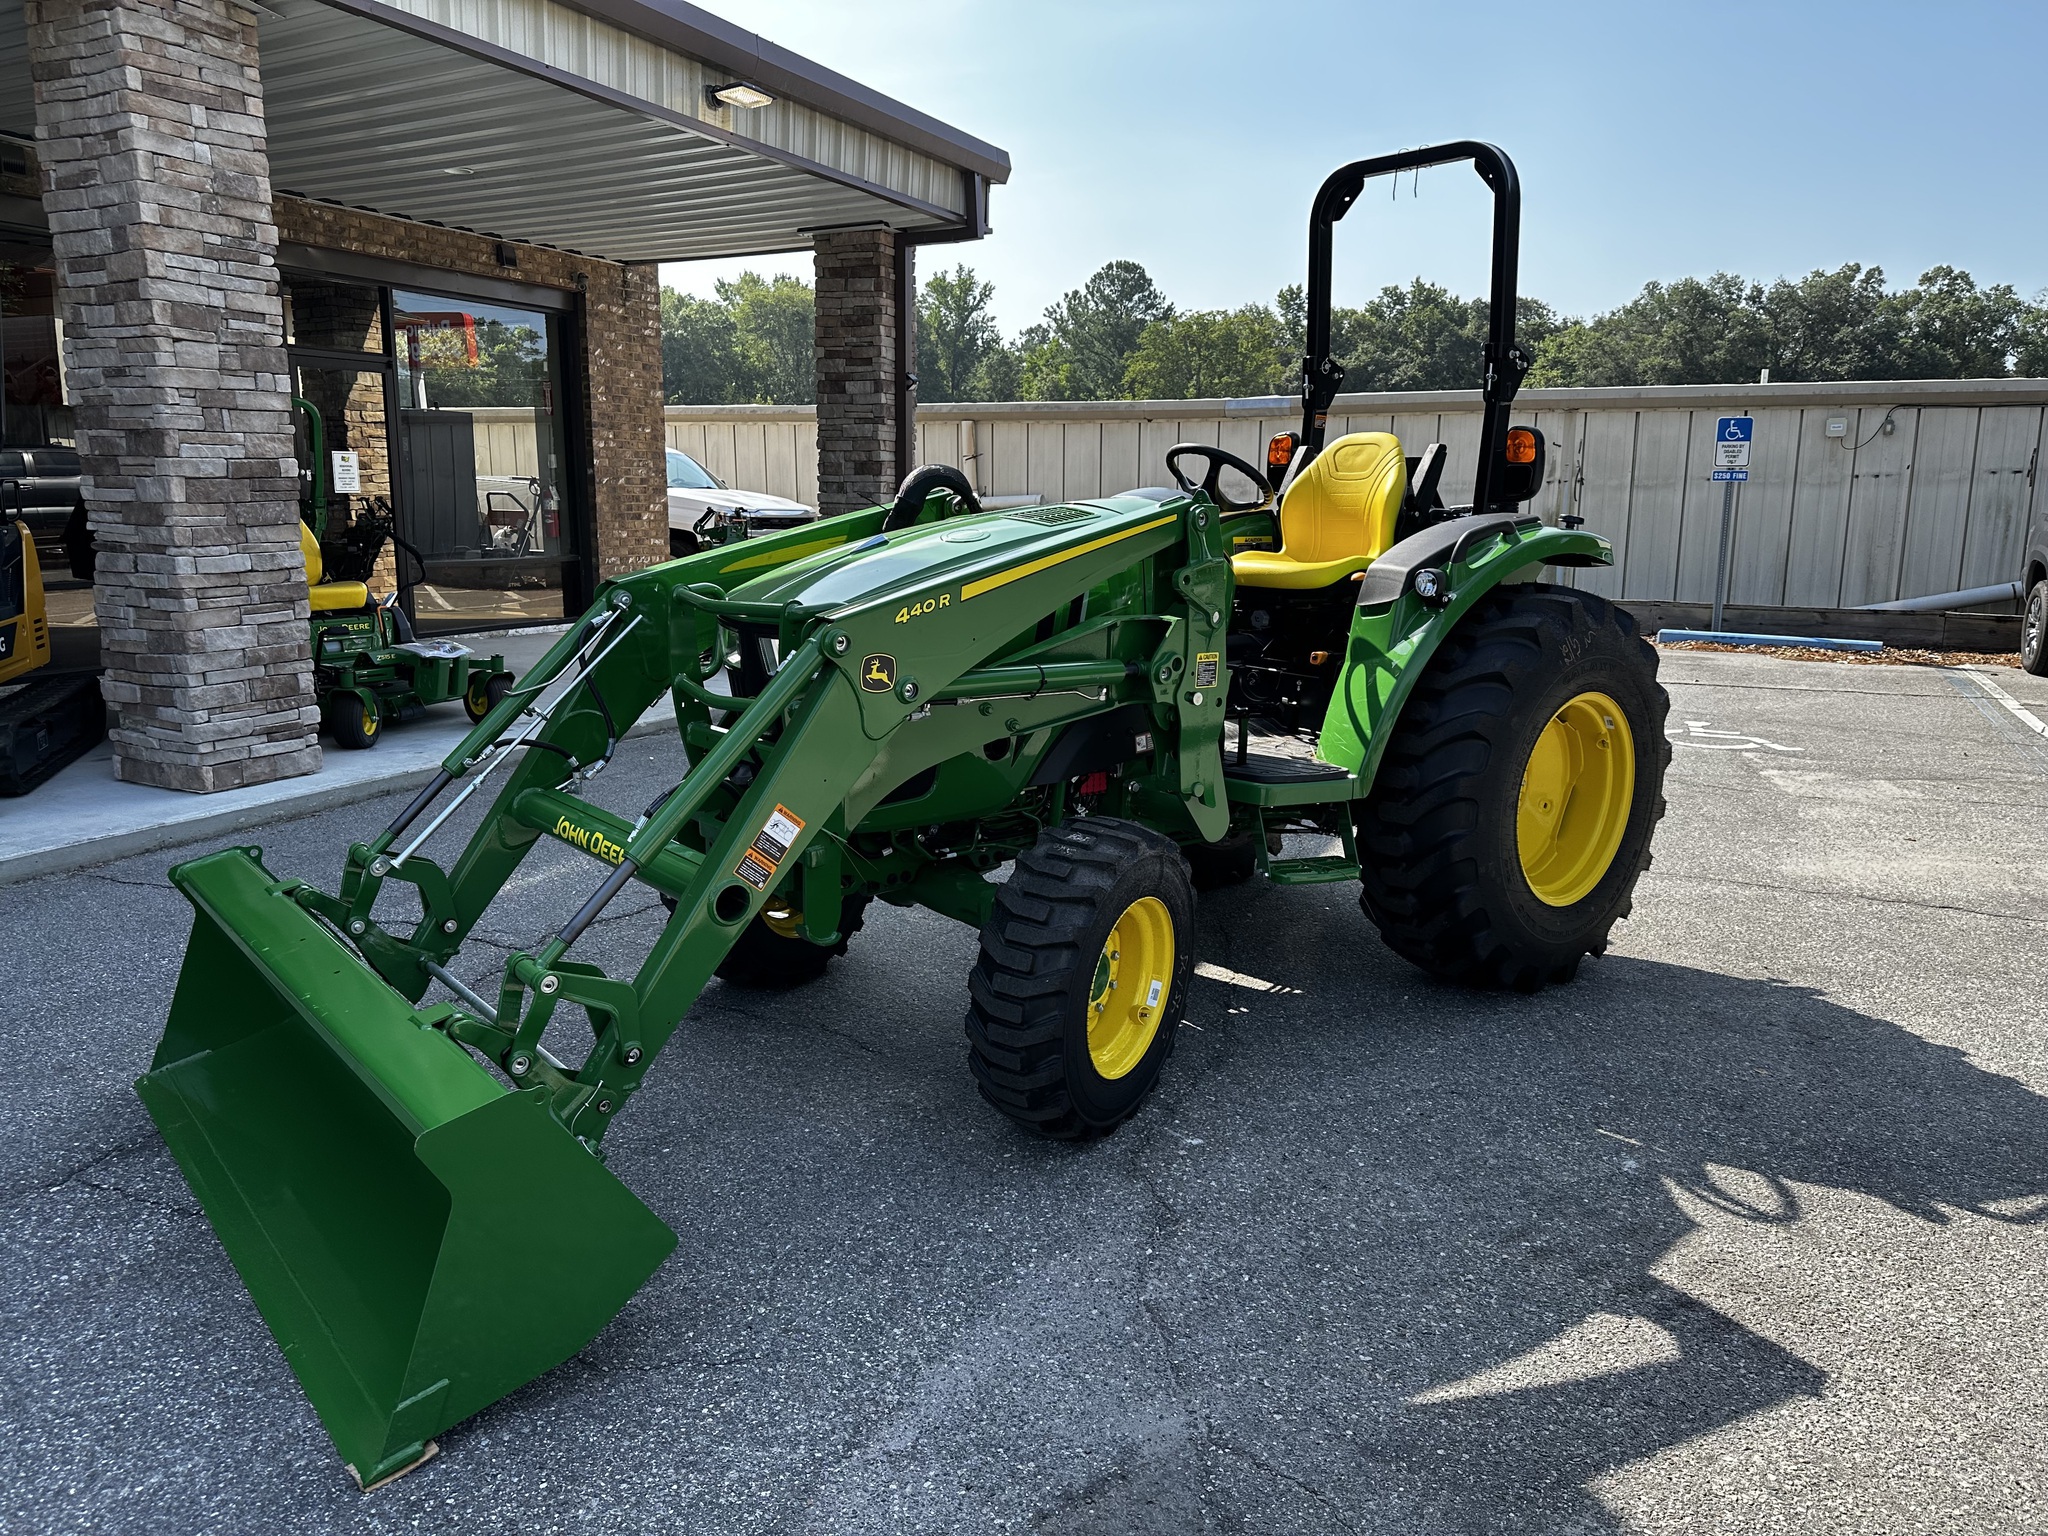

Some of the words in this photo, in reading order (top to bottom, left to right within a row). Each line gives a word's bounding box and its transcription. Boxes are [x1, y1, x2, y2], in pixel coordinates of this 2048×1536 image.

[1713, 472, 1731, 480] $250
[1732, 472, 1747, 480] FINE
[895, 598, 936, 624] 440
[938, 593, 951, 609] R
[782, 809, 802, 826] WARNING
[552, 815, 590, 849] JOHN
[753, 855, 773, 871] WARNING
